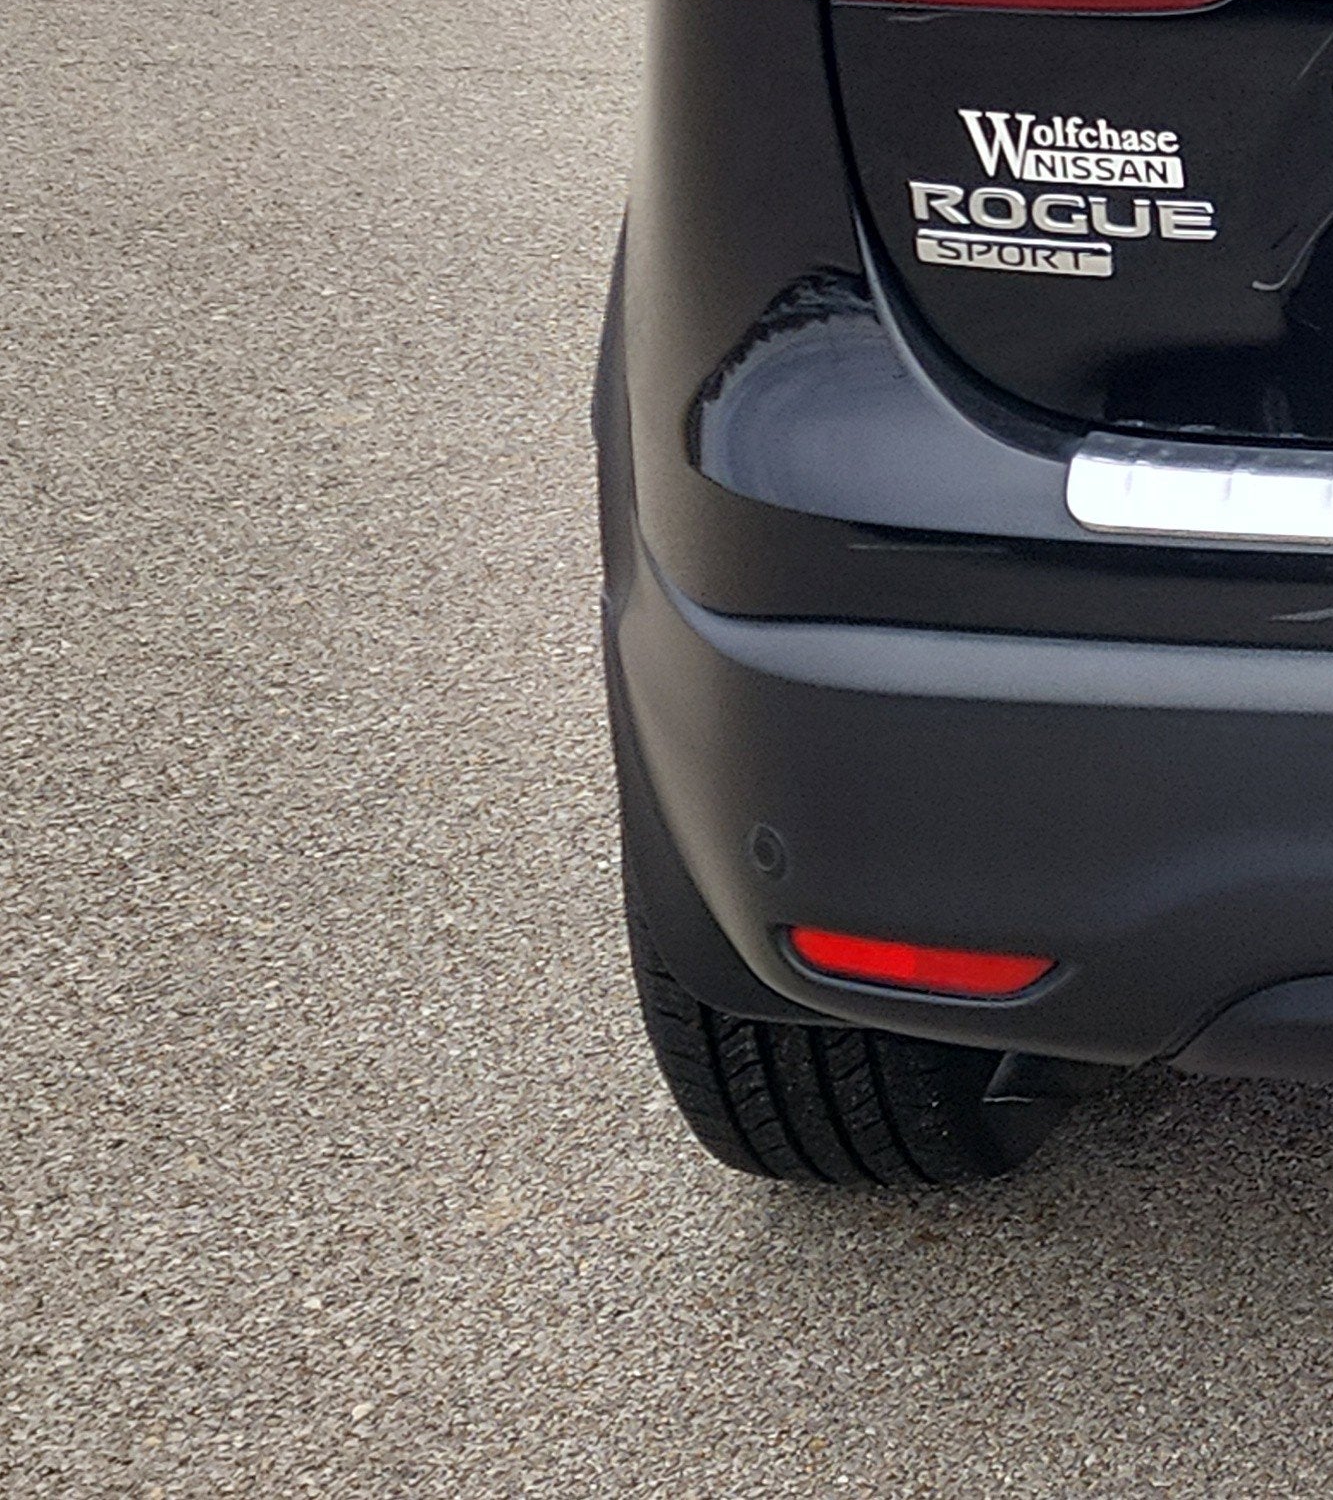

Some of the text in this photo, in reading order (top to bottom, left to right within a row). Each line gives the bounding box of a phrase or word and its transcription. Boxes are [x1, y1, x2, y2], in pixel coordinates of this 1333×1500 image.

[958, 109, 1180, 180] Wolfchase
[1034, 155, 1170, 184] NISSAN
[908, 181, 1218, 240] ROGUE
[937, 241, 1097, 270] SPORT
